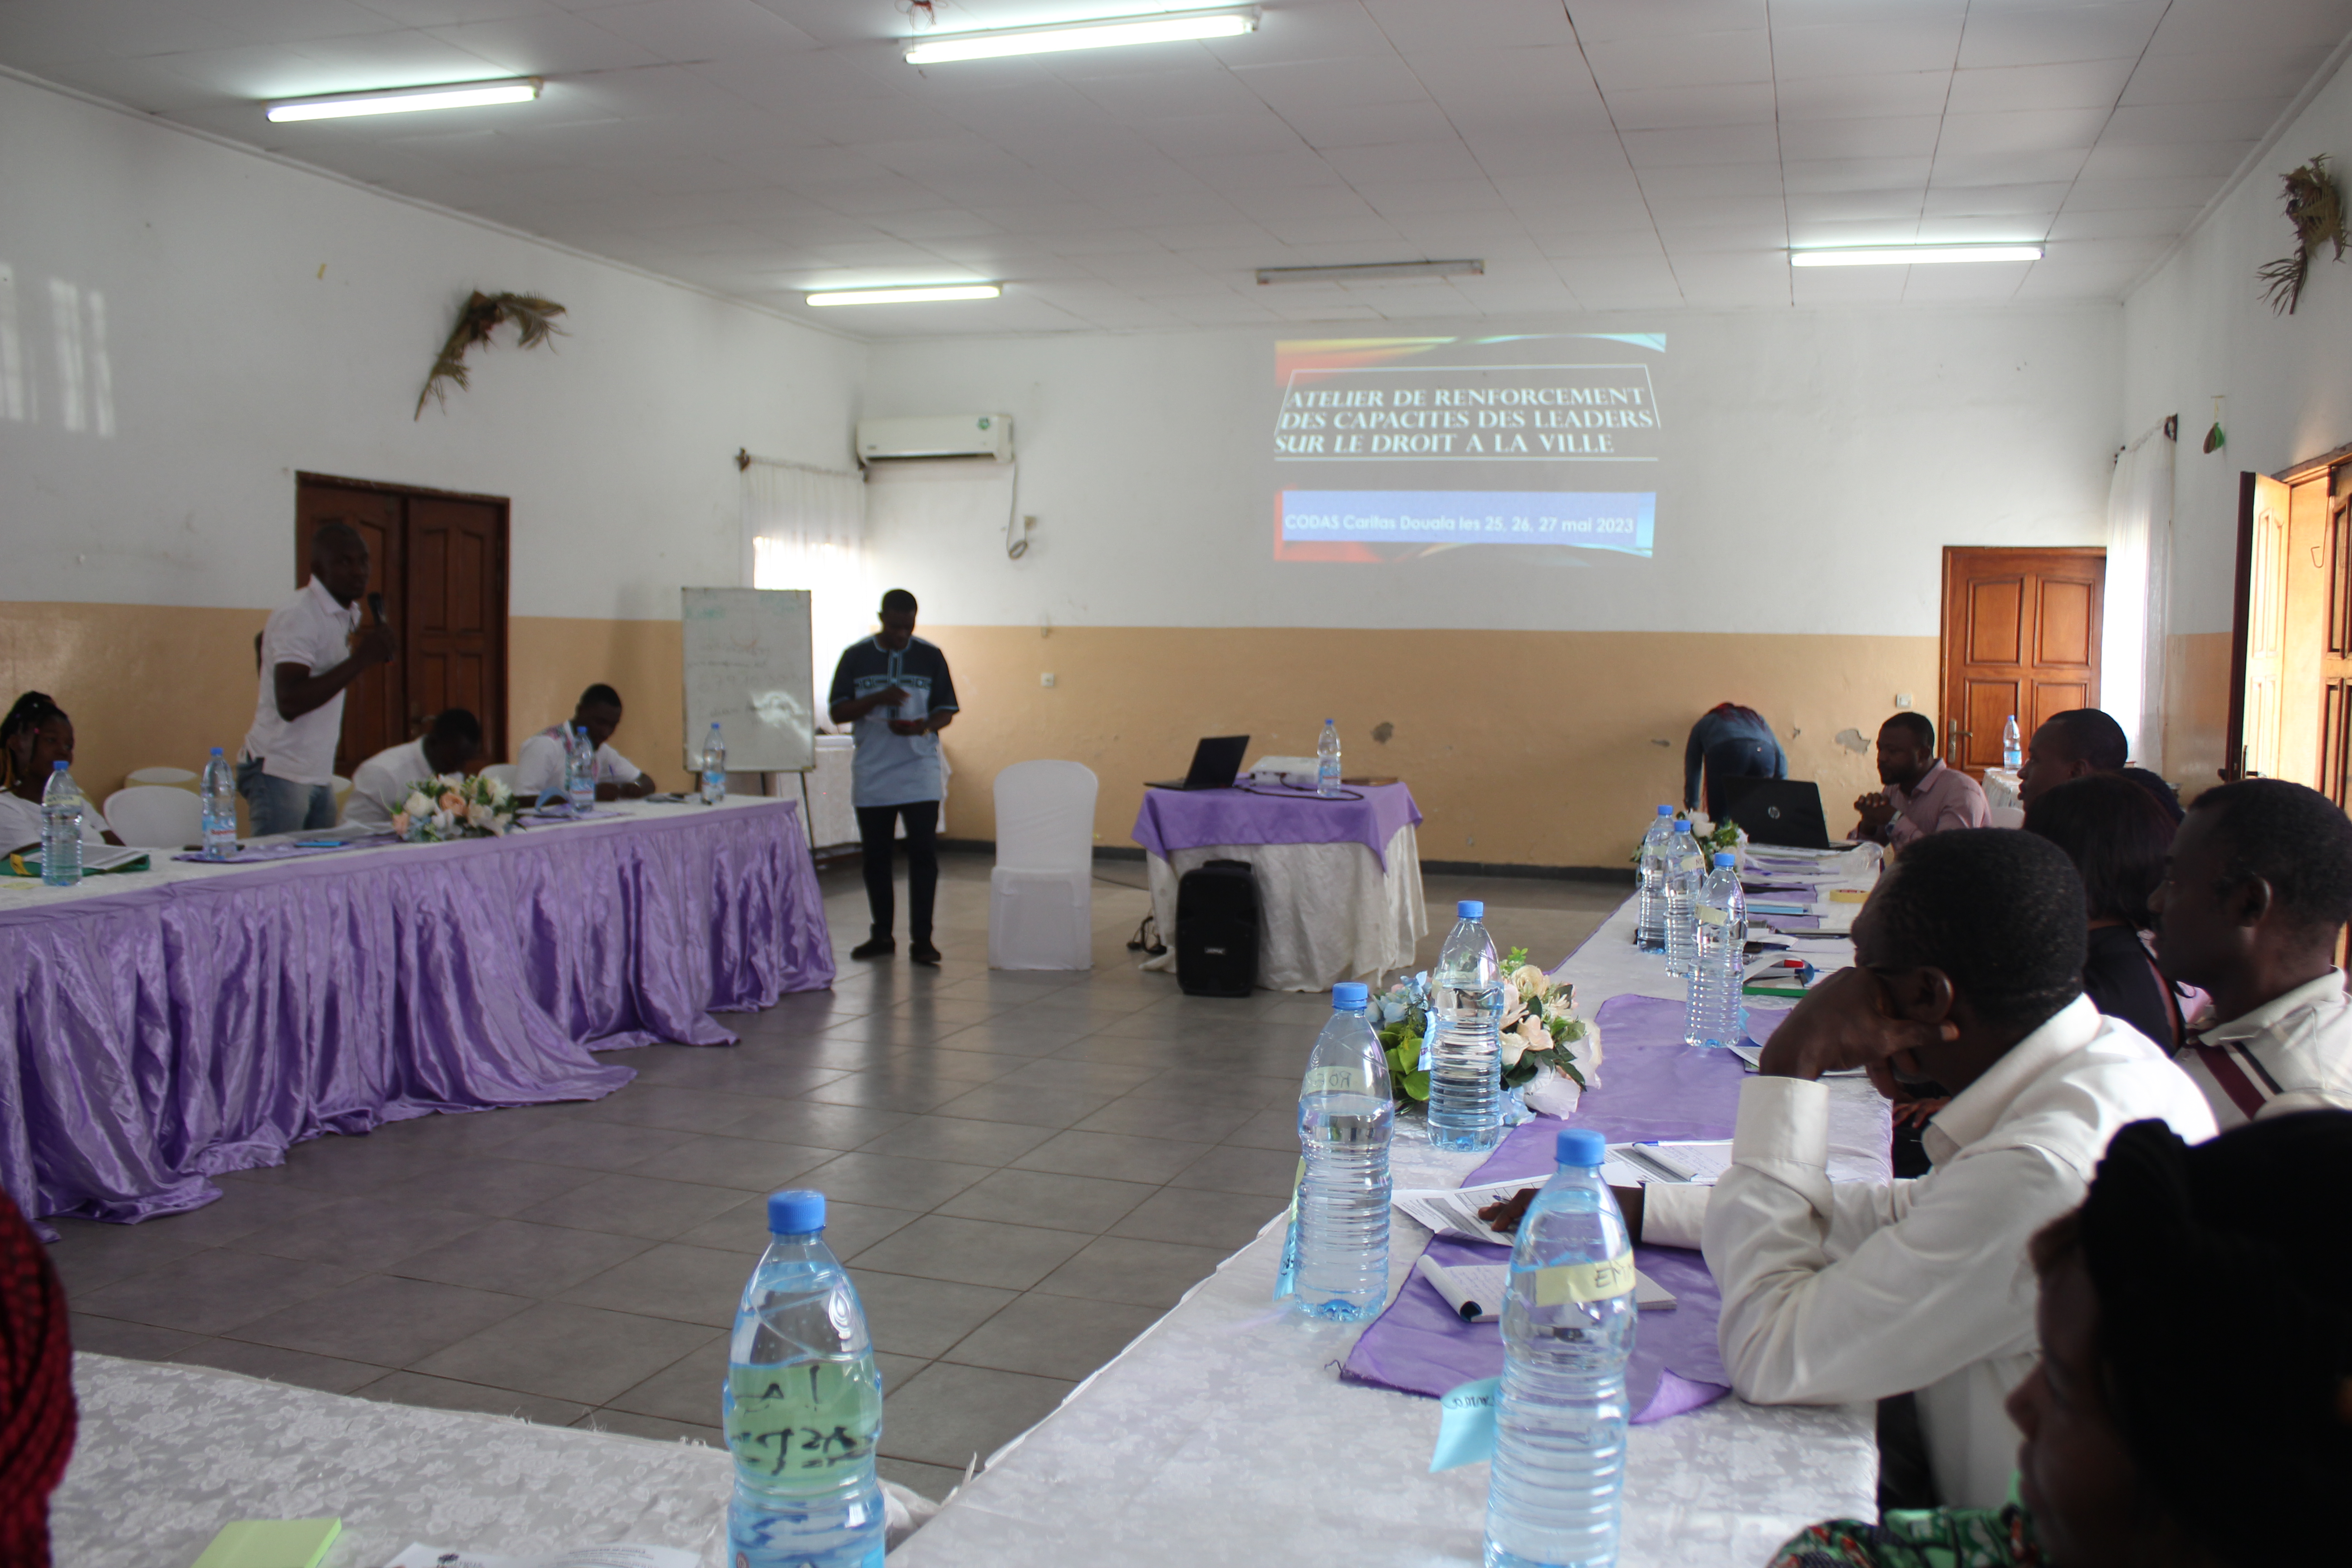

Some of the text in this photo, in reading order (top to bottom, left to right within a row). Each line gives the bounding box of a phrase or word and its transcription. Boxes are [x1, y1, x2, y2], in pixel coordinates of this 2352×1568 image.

[1286, 387, 1645, 407] ATELIER DE RENFORCEMENT
[1280, 409, 1653, 430] DES CAPACITES DES LEADERS
[1274, 433, 1615, 453] SUR LE DROIT A LA VILLE
[1285, 514, 1339, 530] CODAS
[1343, 514, 1396, 531] Caritas
[1400, 514, 1455, 531] Douala
[1459, 515, 1480, 531] les
[1538, 516, 1558, 533] 27
[1561, 517, 1592, 533] mai
[1596, 516, 1634, 534] 2023
